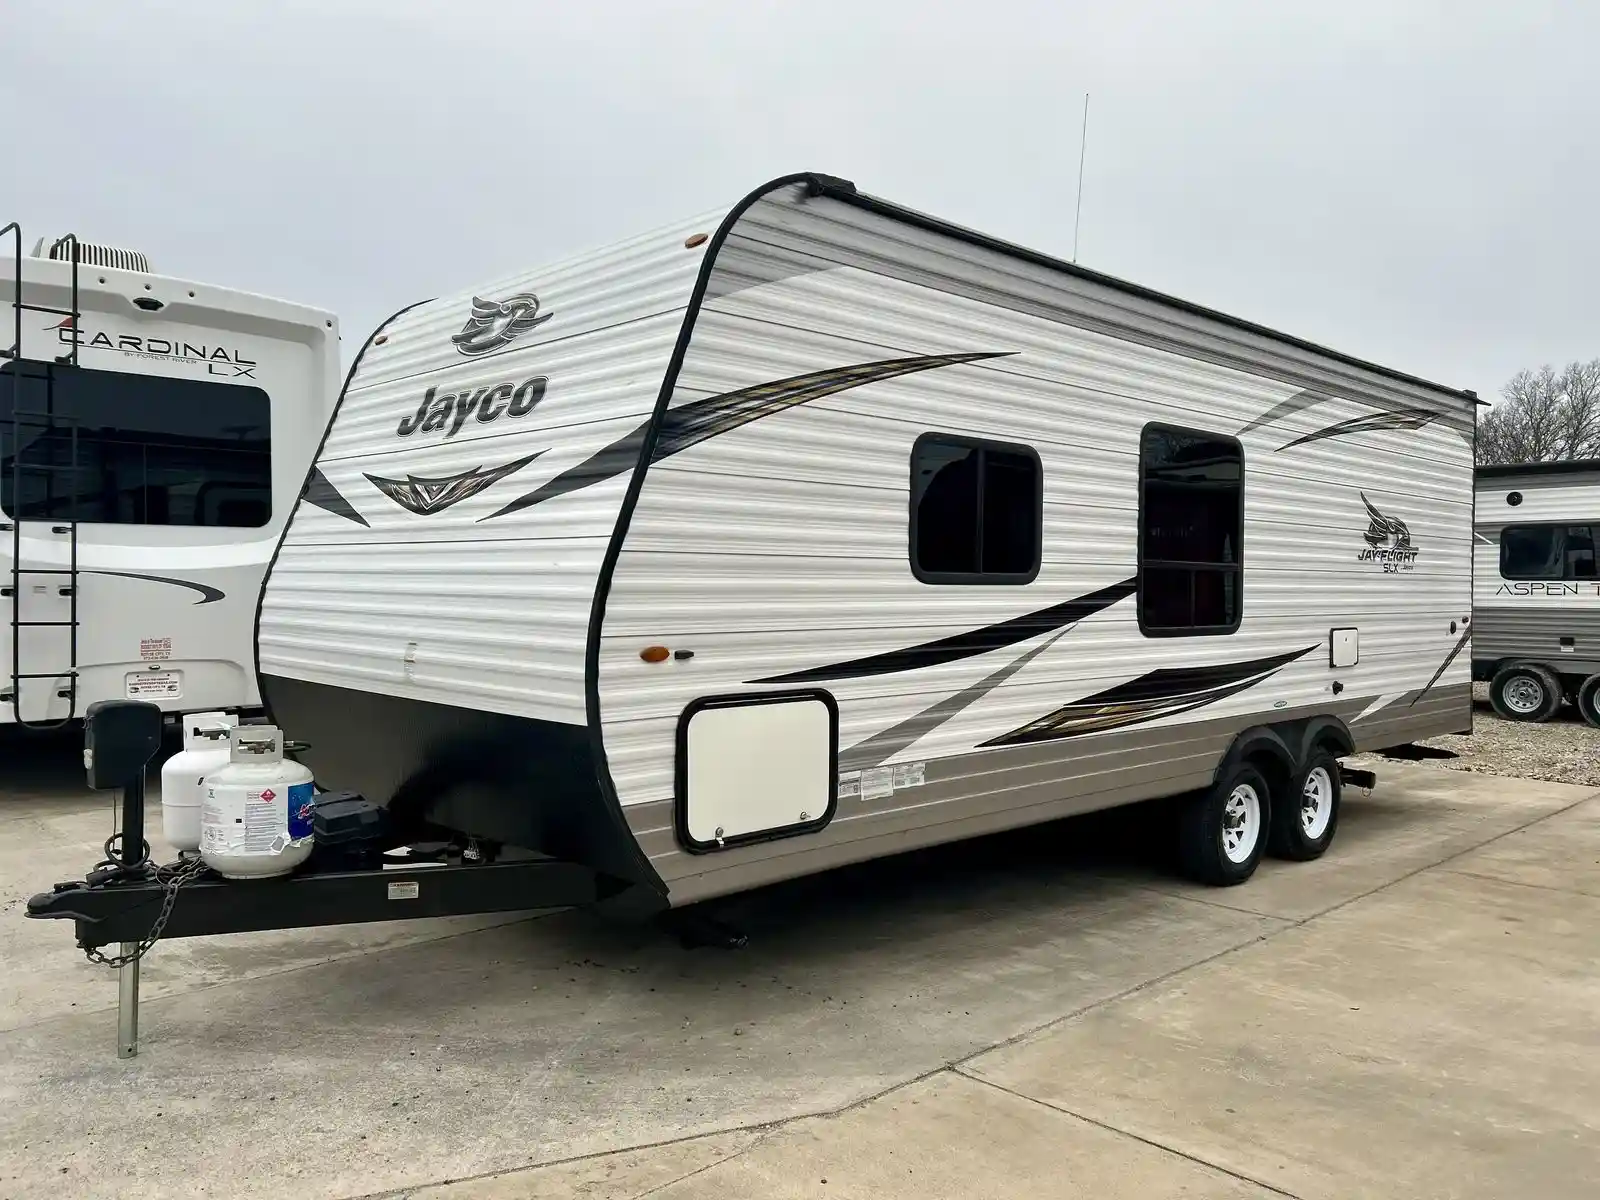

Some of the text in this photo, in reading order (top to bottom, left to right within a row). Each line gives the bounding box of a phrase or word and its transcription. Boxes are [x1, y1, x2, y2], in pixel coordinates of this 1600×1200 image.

[59, 328, 257, 365] CARDINAL
[136, 353, 169, 361] FOREST
[208, 363, 257, 379] LX
[396, 375, 549, 439] Jayco
[1357, 548, 1418, 562] JAY FLIGHT
[1383, 563, 1399, 573] SLX
[1496, 582, 1578, 596] ASPEN
